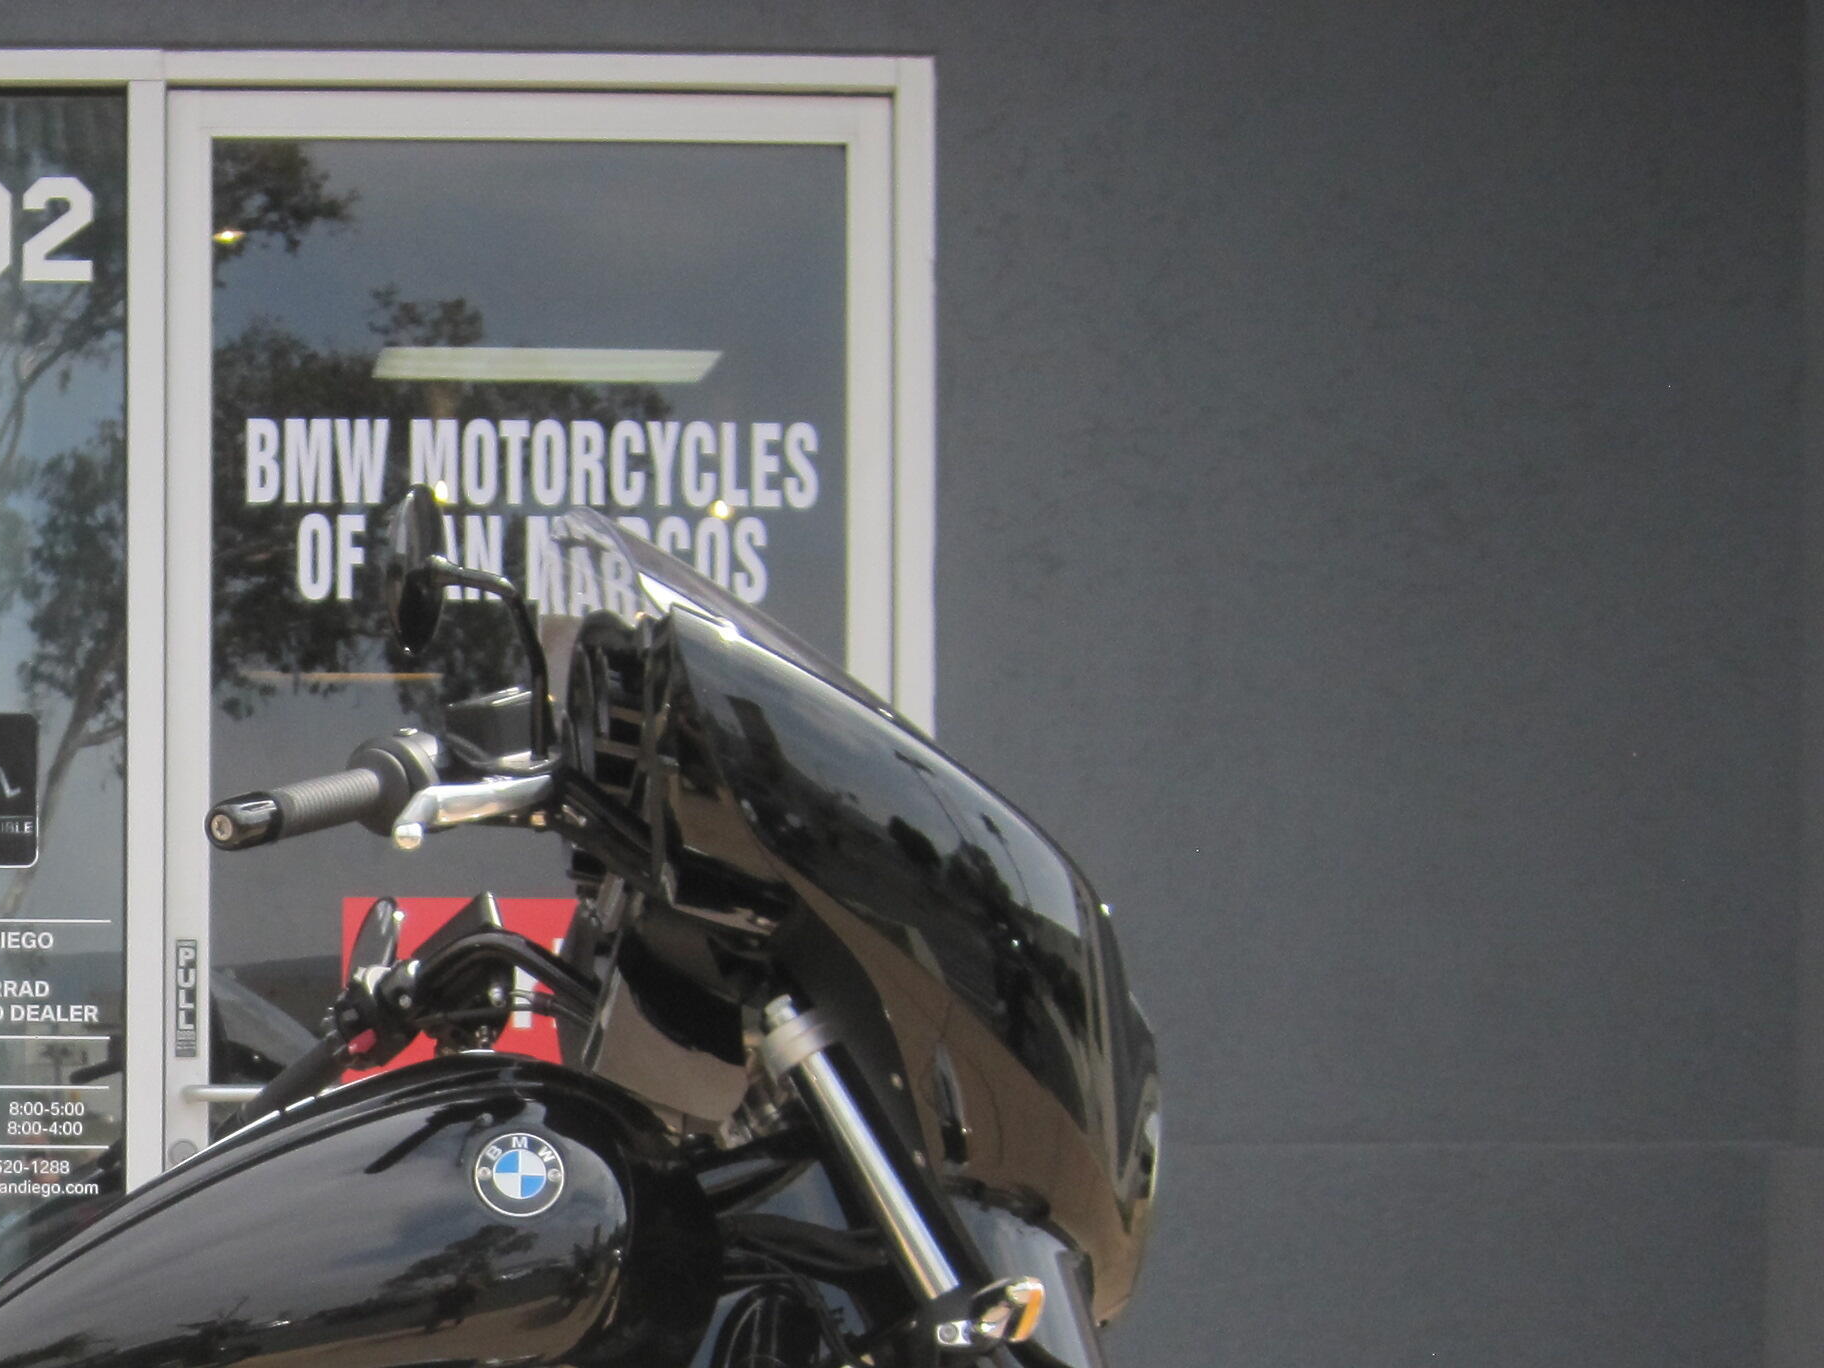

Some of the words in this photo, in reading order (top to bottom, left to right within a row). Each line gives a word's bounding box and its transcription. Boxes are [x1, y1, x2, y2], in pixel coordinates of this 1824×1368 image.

[245, 418, 390, 503] BMW
[409, 419, 819, 510] MOTORCYCLES
[296, 515, 365, 600] OF
[177, 946, 196, 1030] PULL
[10, 1005, 99, 1023] DEALER
[8, 1101, 85, 1117] 8:00-5:00
[7, 1121, 83, 1136] 8:00-4:00
[486, 1136, 556, 1163] BMW
